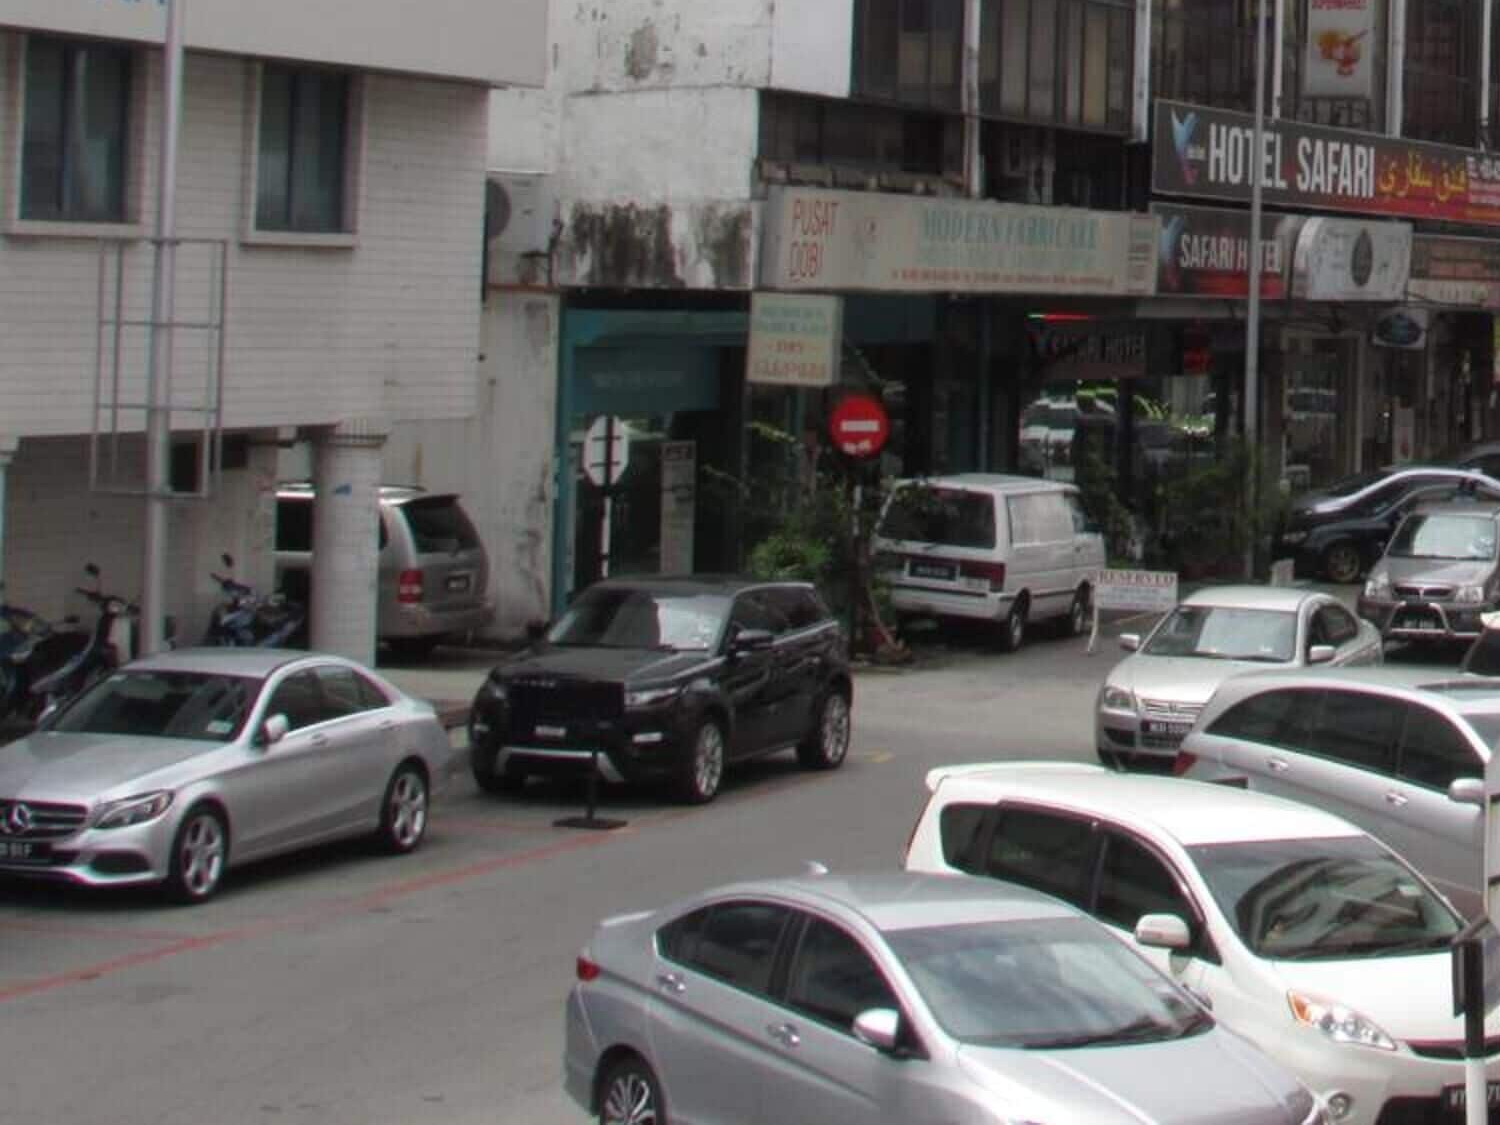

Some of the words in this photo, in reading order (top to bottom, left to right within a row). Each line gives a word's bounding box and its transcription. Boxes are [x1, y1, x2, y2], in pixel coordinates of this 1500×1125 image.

[1208, 123, 1288, 190] HOTEL
[1296, 136, 1376, 199] SAFARI
[793, 198, 840, 236] PUSAT
[1180, 233, 1236, 270] SAFARI
[1237, 238, 1281, 273] HTEL
